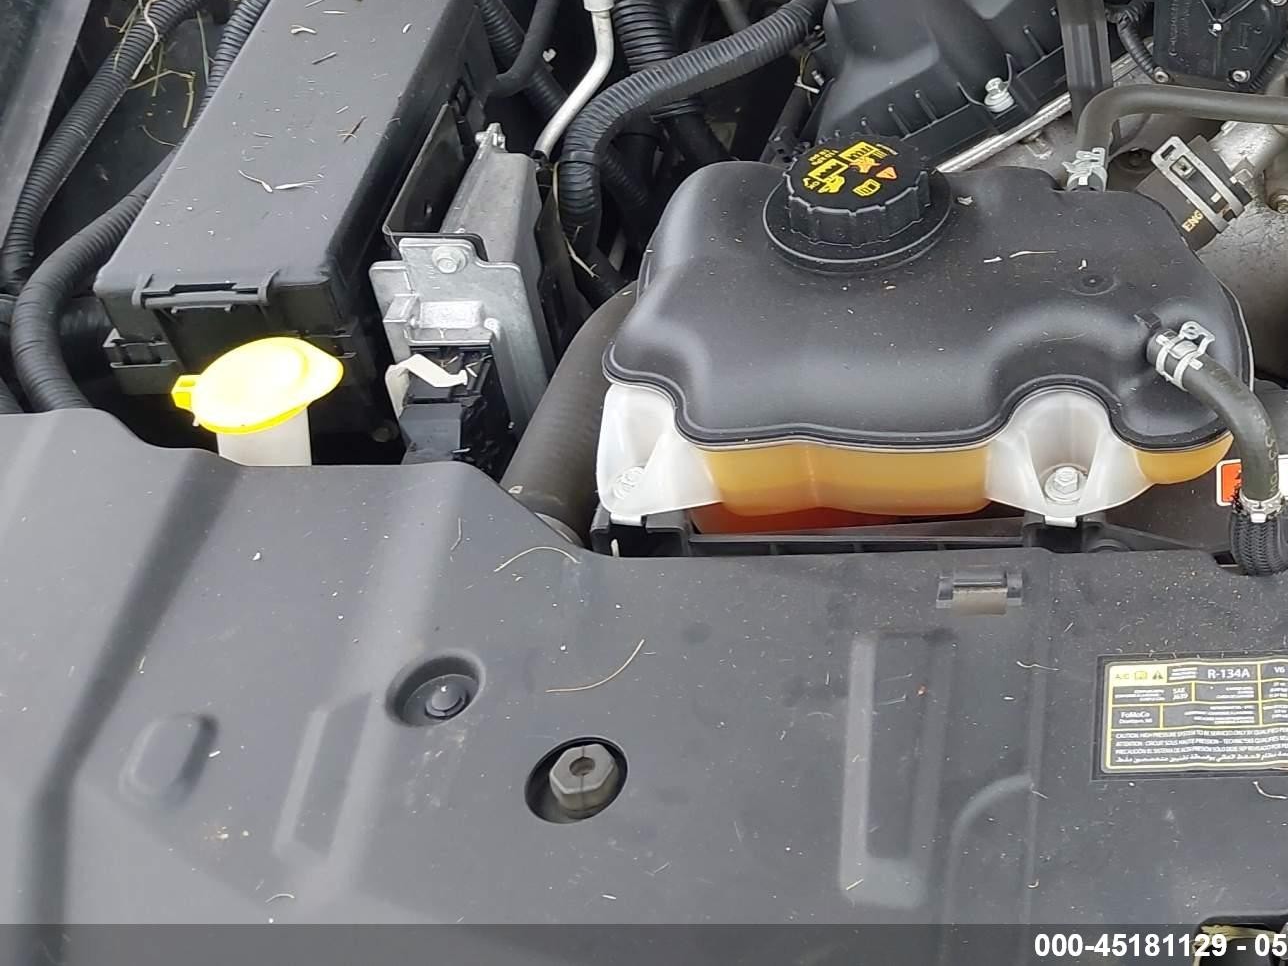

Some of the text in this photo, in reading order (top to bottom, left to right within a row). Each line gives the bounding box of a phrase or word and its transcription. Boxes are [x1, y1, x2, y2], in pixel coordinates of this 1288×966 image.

[1182, 210, 1204, 232] ENG
[1207, 668, 1250, 679] R-134A
[1273, 666, 1285, 674] V6
